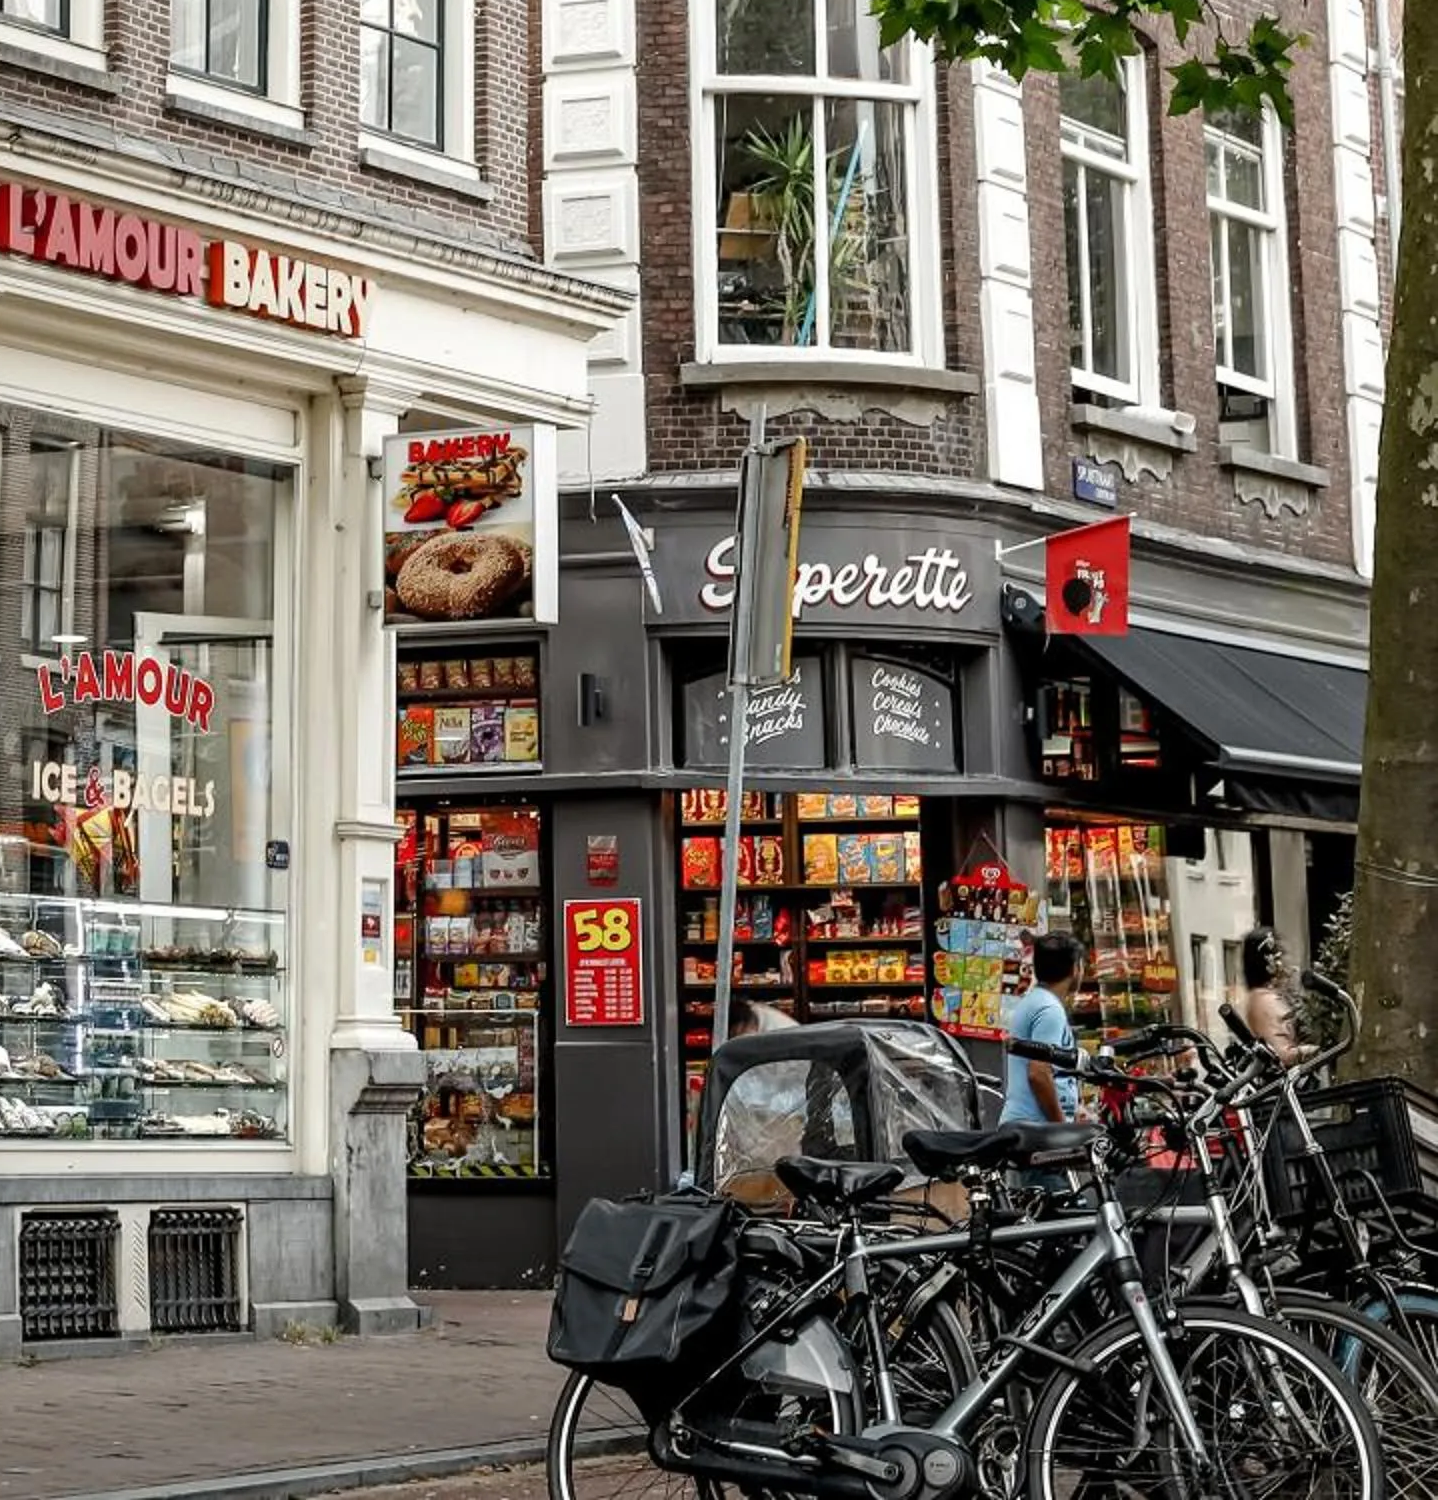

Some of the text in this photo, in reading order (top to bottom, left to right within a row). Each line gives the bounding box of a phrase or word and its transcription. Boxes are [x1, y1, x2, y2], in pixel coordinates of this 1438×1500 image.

[6, 184, 377, 338] L'AMOUR BAKERY
[408, 431, 513, 465] BAKERY
[699, 534, 974, 619] Sperette
[37, 649, 215, 735] L'AMOUR
[744, 687, 807, 716] andy
[871, 667, 923, 697] Cookies
[872, 692, 923, 719] Cereals
[32, 760, 215, 819] ICE & BAGELS
[573, 907, 632, 951] 58
